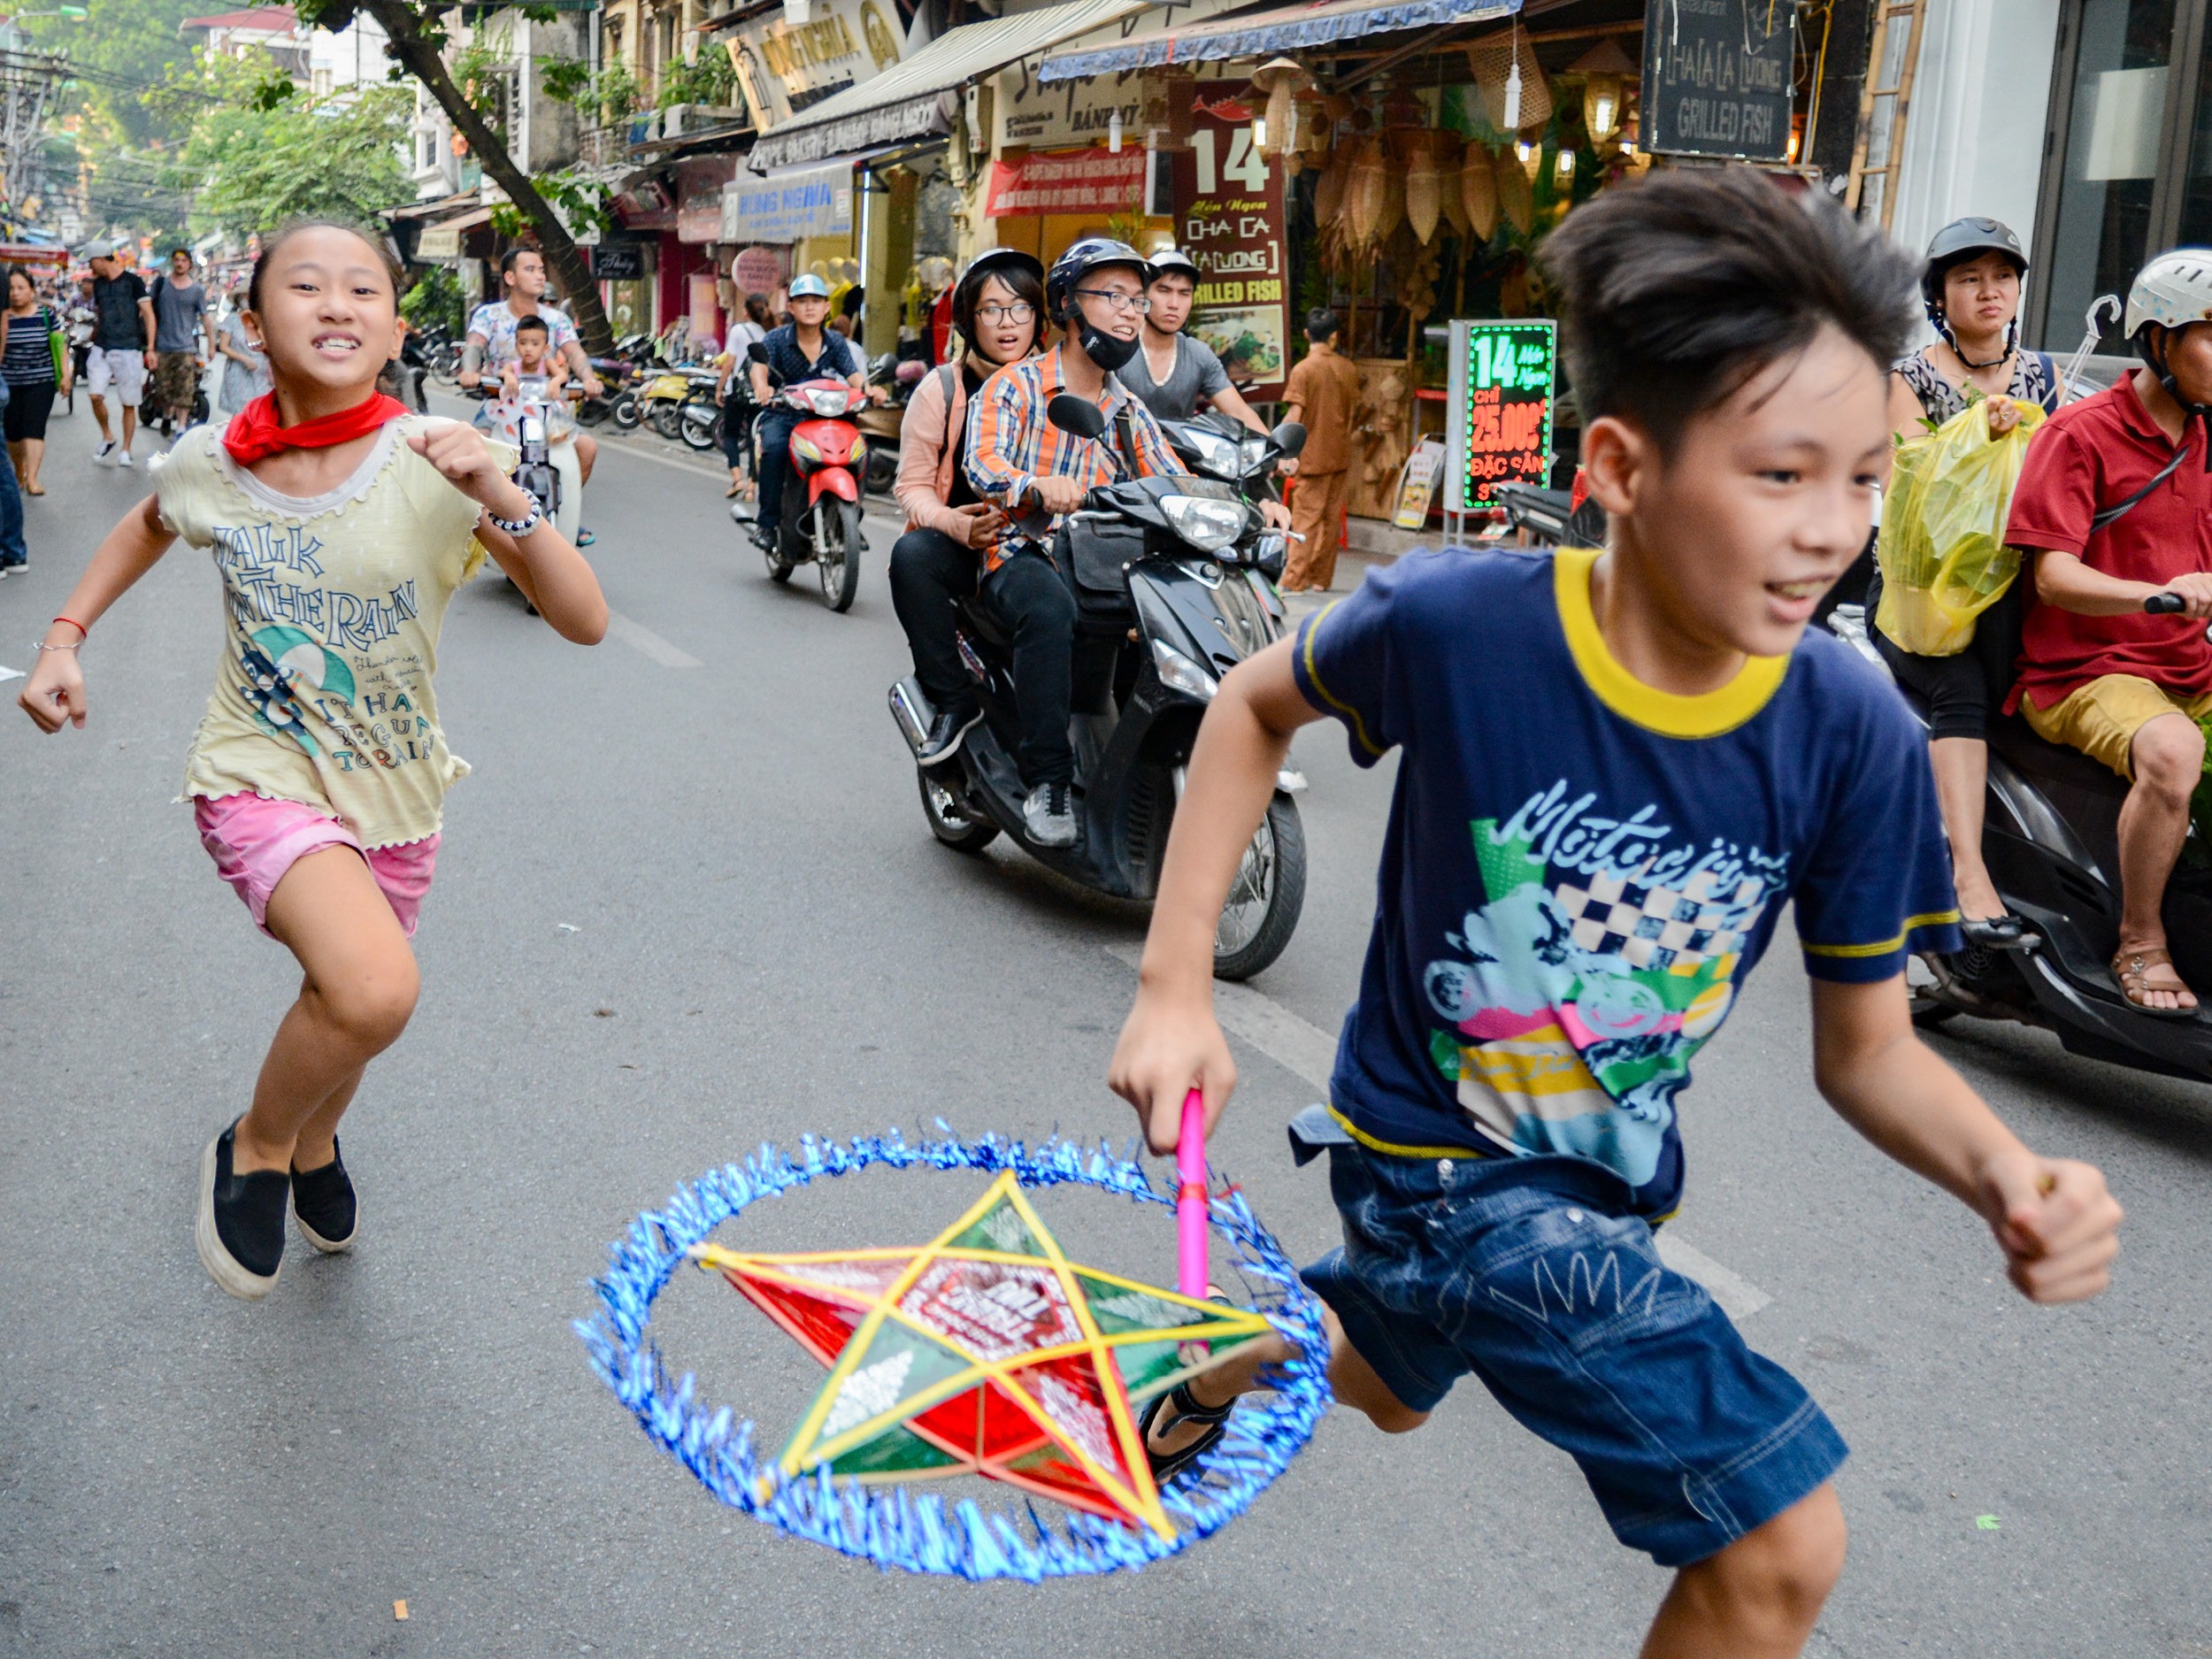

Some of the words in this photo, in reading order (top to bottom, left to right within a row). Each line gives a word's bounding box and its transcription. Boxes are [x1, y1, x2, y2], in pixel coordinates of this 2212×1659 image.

[1678, 97, 1739, 142] GRILLED
[1740, 103, 1774, 144] FISH
[1184, 127, 1271, 194] 14
[1192, 280, 1244, 305] RILLED
[1247, 279, 1282, 302] FISH
[1474, 334, 1518, 388] 14
[1470, 455, 1509, 480] ĐẶC
[236, 565, 326, 634] THE
[326, 579, 419, 653] RAIN
[314, 690, 354, 723] IT
[364, 686, 419, 718] HA
